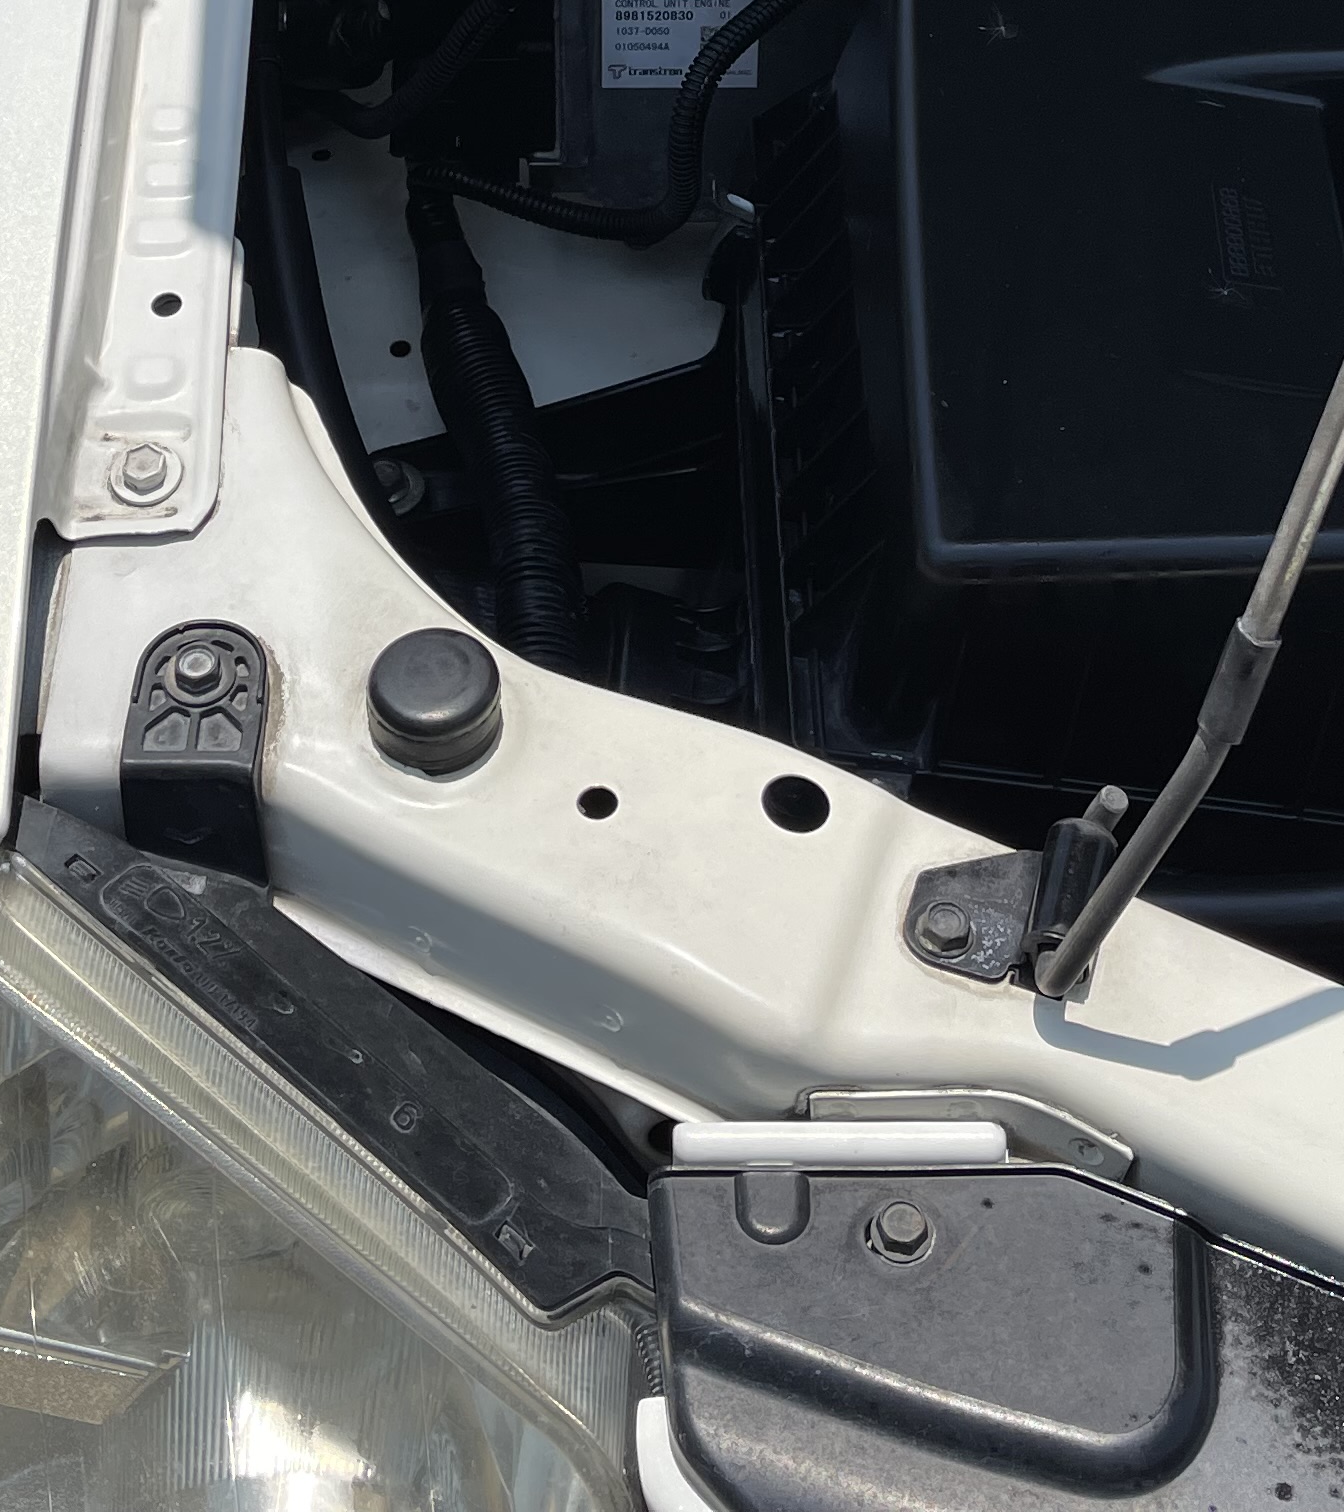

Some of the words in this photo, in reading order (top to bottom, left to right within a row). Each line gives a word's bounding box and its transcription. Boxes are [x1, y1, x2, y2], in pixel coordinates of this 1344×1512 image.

[615, 0, 658, 8] CONTROL
[663, 0, 688, 8] UNIT
[695, 0, 731, 8] ENGINE
